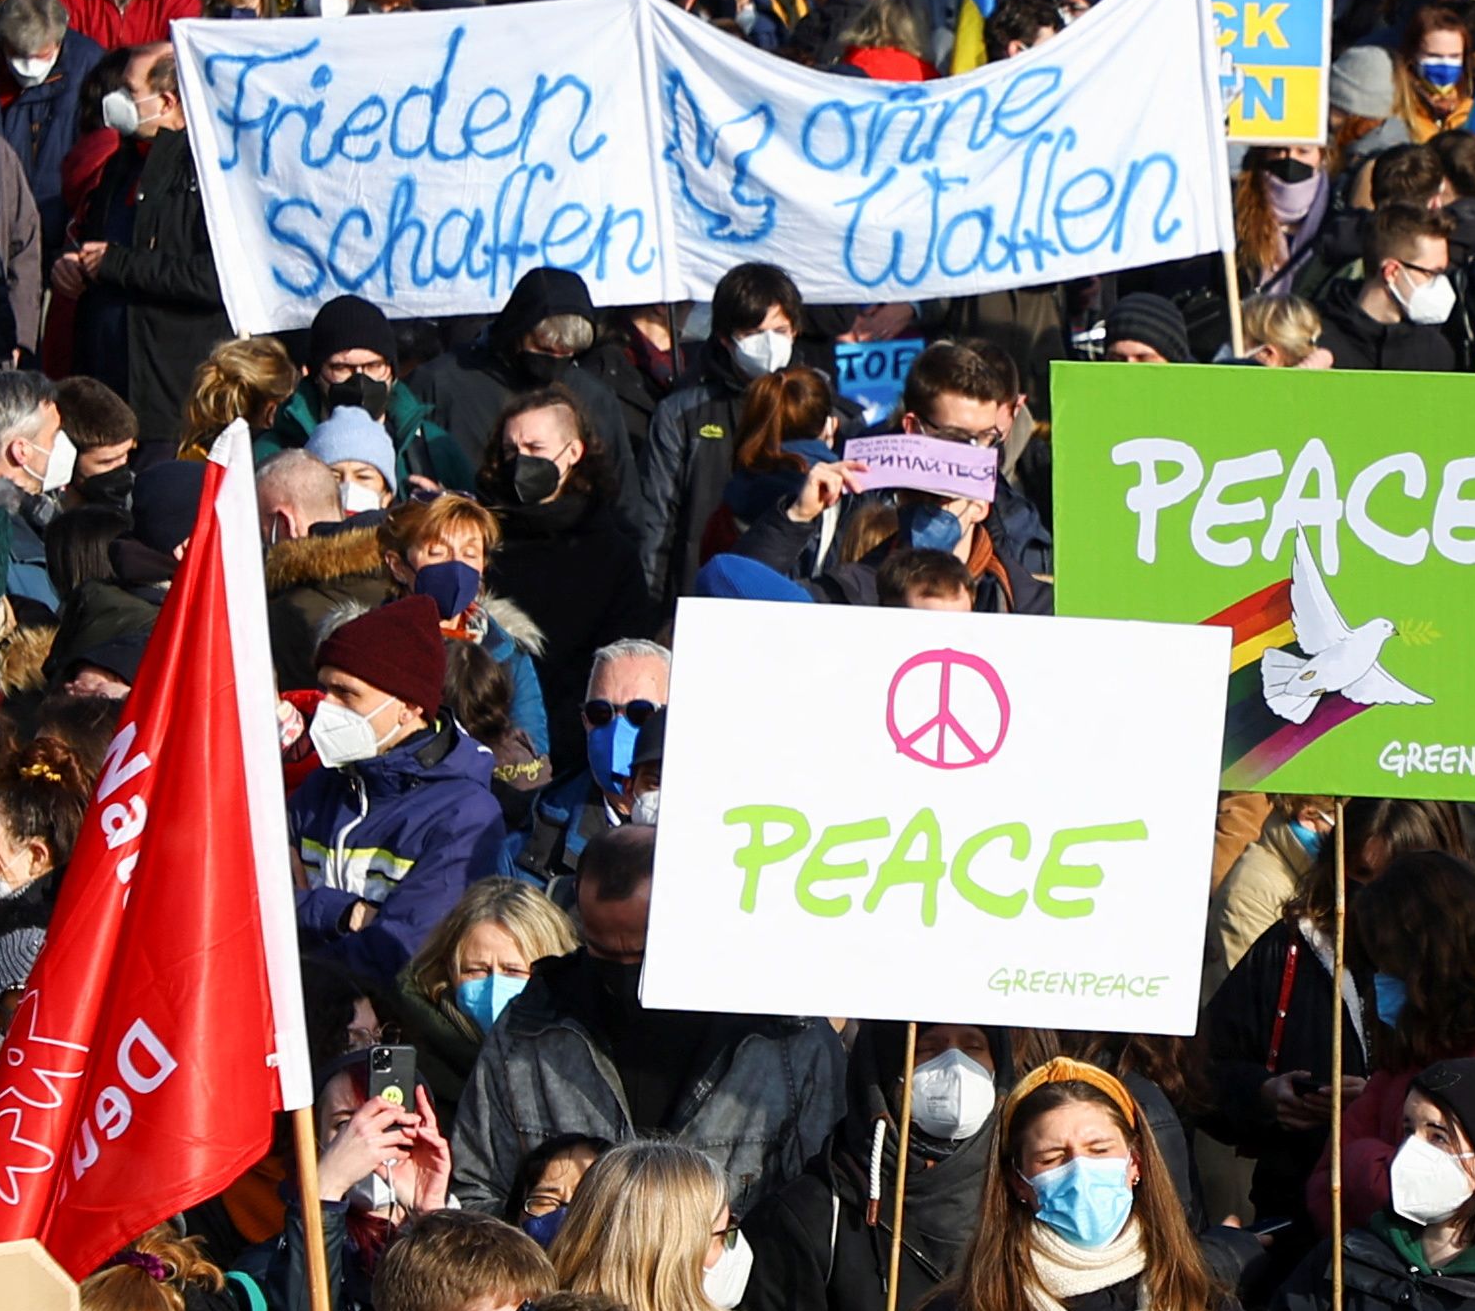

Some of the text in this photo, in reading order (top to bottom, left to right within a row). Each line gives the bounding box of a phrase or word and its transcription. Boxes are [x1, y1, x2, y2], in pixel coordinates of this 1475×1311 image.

[204, 24, 607, 176] Frieden
[801, 66, 1063, 174] ohne
[265, 163, 658, 298] schaffen
[833, 129, 1182, 289] Waffen
[722, 803, 1148, 927] PEACE
[986, 967, 1170, 1000] GREENPEACE
